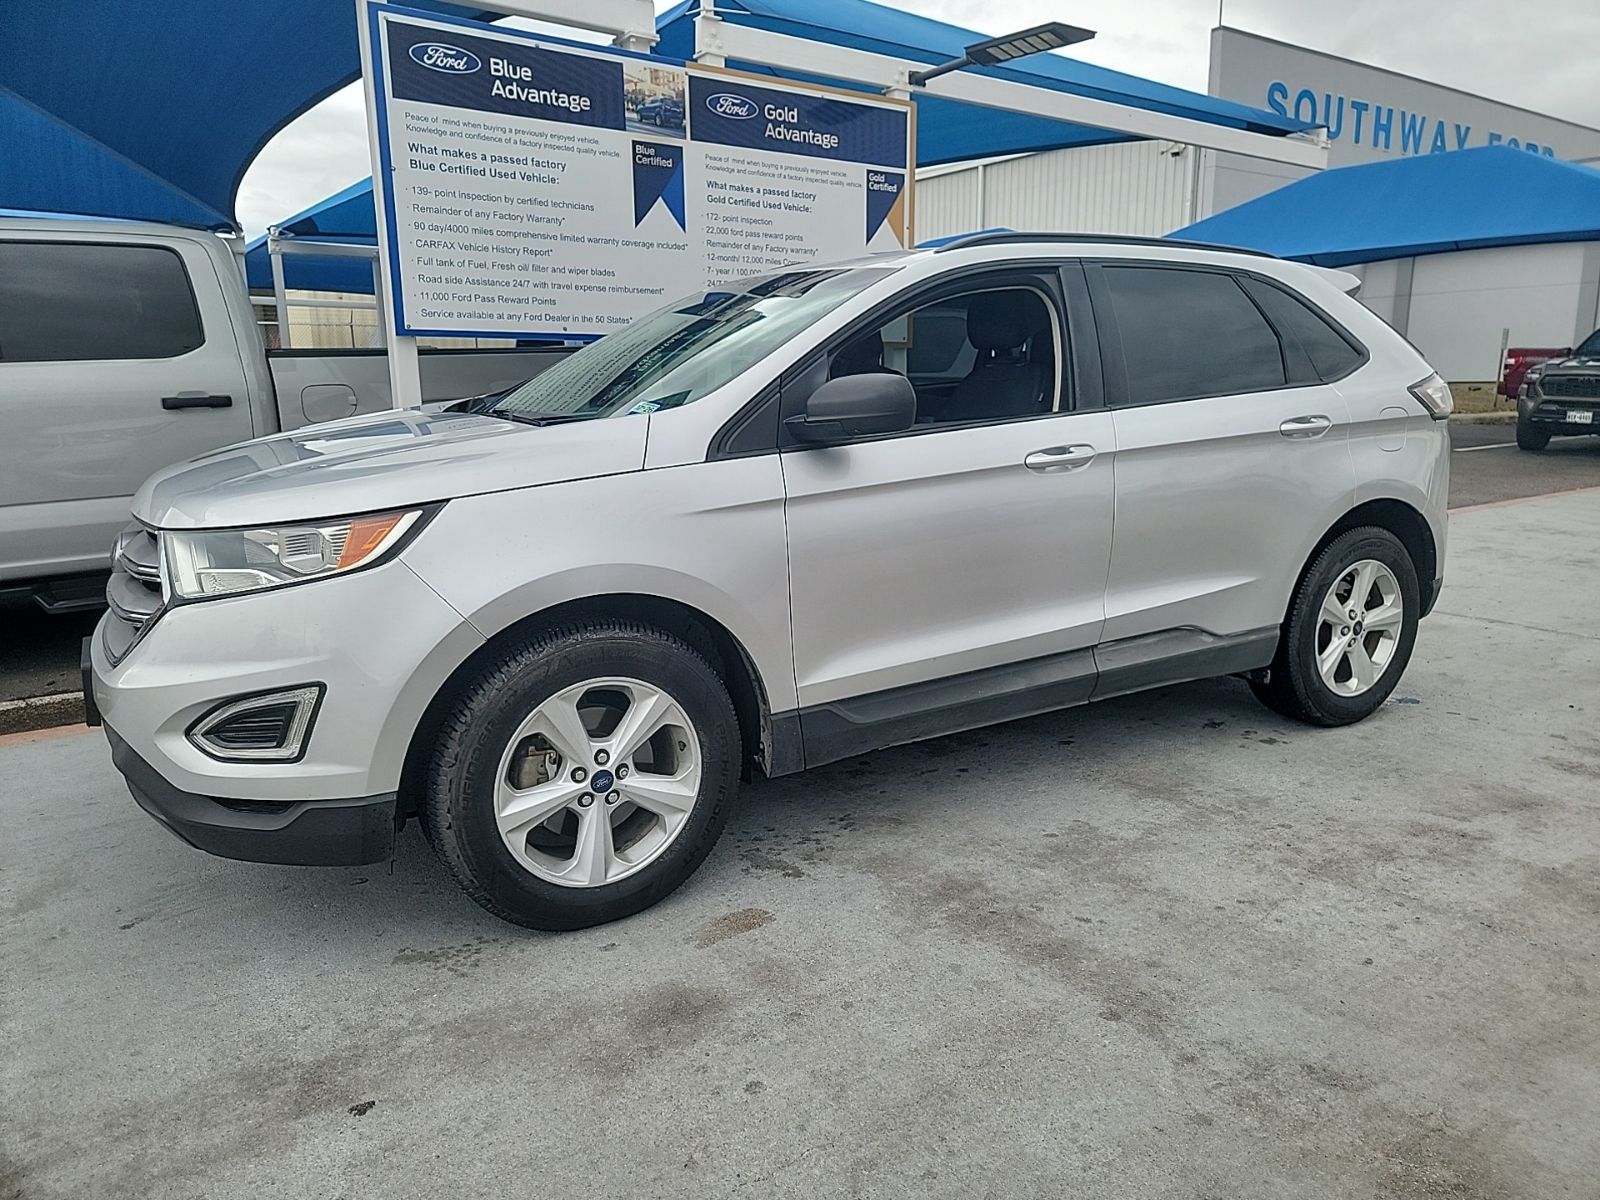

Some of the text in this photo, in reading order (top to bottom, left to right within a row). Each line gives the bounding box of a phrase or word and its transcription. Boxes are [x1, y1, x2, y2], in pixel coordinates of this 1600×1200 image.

[422, 46, 468, 71] Ford
[490, 58, 532, 81] Blue
[491, 80, 590, 112] Advantage
[716, 95, 748, 116] Ford
[764, 104, 798, 123] Gold
[1267, 81, 1471, 154] SOUTHWAY
[405, 112, 429, 122] Peace
[442, 119, 460, 127] mind
[462, 121, 482, 129] when
[483, 123, 507, 134] buying
[514, 128, 548, 140] previously
[550, 133, 575, 142] enjoyed
[765, 123, 838, 149] Advantage
[405, 123, 447, 137] Knowledge
[464, 132, 503, 143] confidence
[519, 138, 542, 150] factory
[544, 141, 575, 152] inspected
[576, 147, 597, 157] quality
[636, 145, 655, 155] Blue
[407, 142, 438, 155] What
[441, 148, 477, 160] makes
[490, 155, 528, 166] passed
[531, 157, 566, 172] factory
[636, 155, 672, 167] Certified
[410, 158, 559, 185] Blue Certified Used Vehicle:
[869, 173, 885, 182] Gold
[706, 180, 727, 190] What
[729, 184, 754, 193] makes
[762, 188, 790, 197] passed
[791, 189, 816, 202] factory
[869, 182, 897, 192] Certified
[412, 186, 594, 212] 139- point inspection by certified technicians
[707, 194, 812, 213] Gold Certified Used Vehicle:
[412, 203, 462, 216] Remainder
[464, 208, 473, 217] of
[475, 211, 491, 221] any
[493, 210, 524, 224] Factory
[740, 216, 773, 226] inspection
[414, 221, 426, 231] 90
[428, 223, 469, 234] day/4000
[471, 226, 494, 236] miles
[496, 230, 558, 241] comprehensive
[560, 233, 585, 243] limited
[587, 237, 620, 248] warranty
[621, 240, 654, 250] coverage
[730, 228, 744, 237] ford
[416, 239, 456, 250] CARFAX
[457, 242, 489, 253] Vehicle
[491, 244, 520, 257] History
[706, 239, 743, 250] Remainder
[752, 244, 764, 253] any
[765, 244, 788, 255] Factory
[417, 257, 433, 266] Full
[436, 258, 455, 267] tank
[456, 259, 466, 268] of
[491, 261, 516, 271] Fresh
[518, 263, 530, 272] oil/
[532, 264, 549, 273] filter
[551, 266, 566, 274] and
[568, 266, 589, 276] wiper
[590, 267, 616, 277] blades
[418, 274, 442, 284] Road
[444, 275, 463, 285] side
[464, 276, 510, 287] Assistance
[512, 279, 530, 288] 24/7
[532, 281, 549, 289] with
[551, 282, 572, 290] travel
[574, 284, 606, 293] expense
[420, 291, 556, 306] 11,000 Ford Pass Reward Points
[421, 308, 454, 318] Service
[456, 310, 494, 320] available
[506, 313, 522, 323] any
[524, 312, 542, 321] Ford
[544, 313, 570, 322] Dealer
[572, 314, 579, 322] in
[581, 315, 593, 323] the
[596, 315, 605, 324] 50
